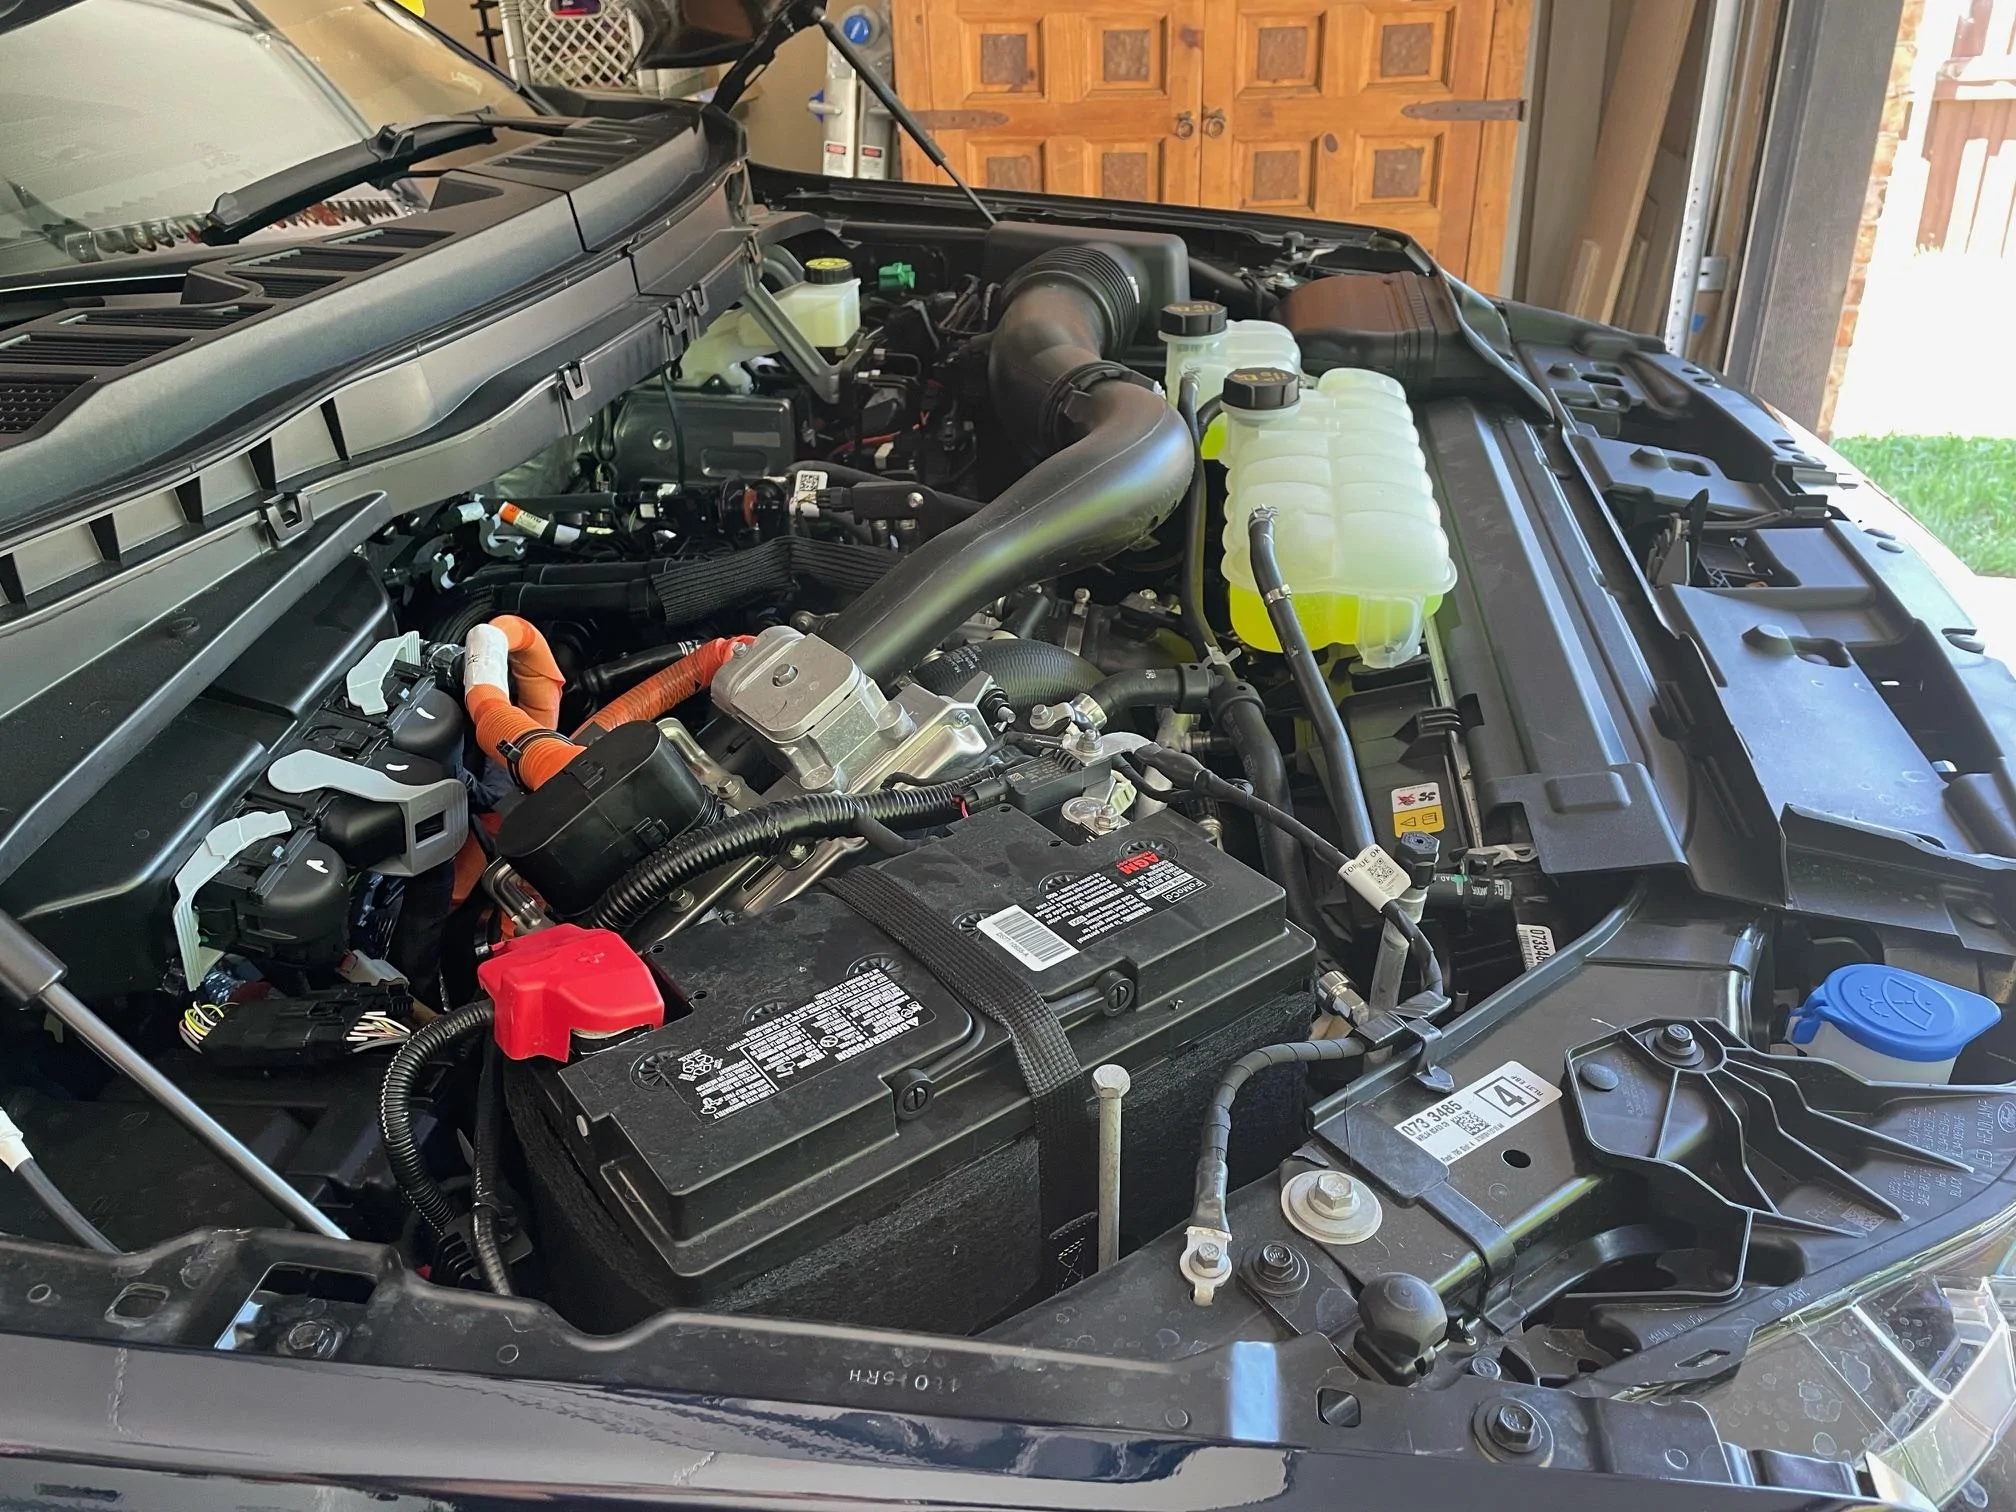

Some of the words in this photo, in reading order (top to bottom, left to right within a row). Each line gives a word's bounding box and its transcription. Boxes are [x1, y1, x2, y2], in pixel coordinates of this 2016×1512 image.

[1118, 852, 1161, 875] AGM
[1343, 857, 1370, 876] TORUE
[1370, 847, 1381, 858] OK
[1166, 879, 1202, 901] FoMoCo
[834, 1022, 910, 1061] DANGER/POISON
[1494, 1085, 1526, 1107] 4
[1402, 1119, 1430, 1136] 073
[1427, 1100, 1463, 1122] 3485
[1976, 1099, 1994, 1146] HEADLAMP
[1976, 1148, 1993, 1168] LED
